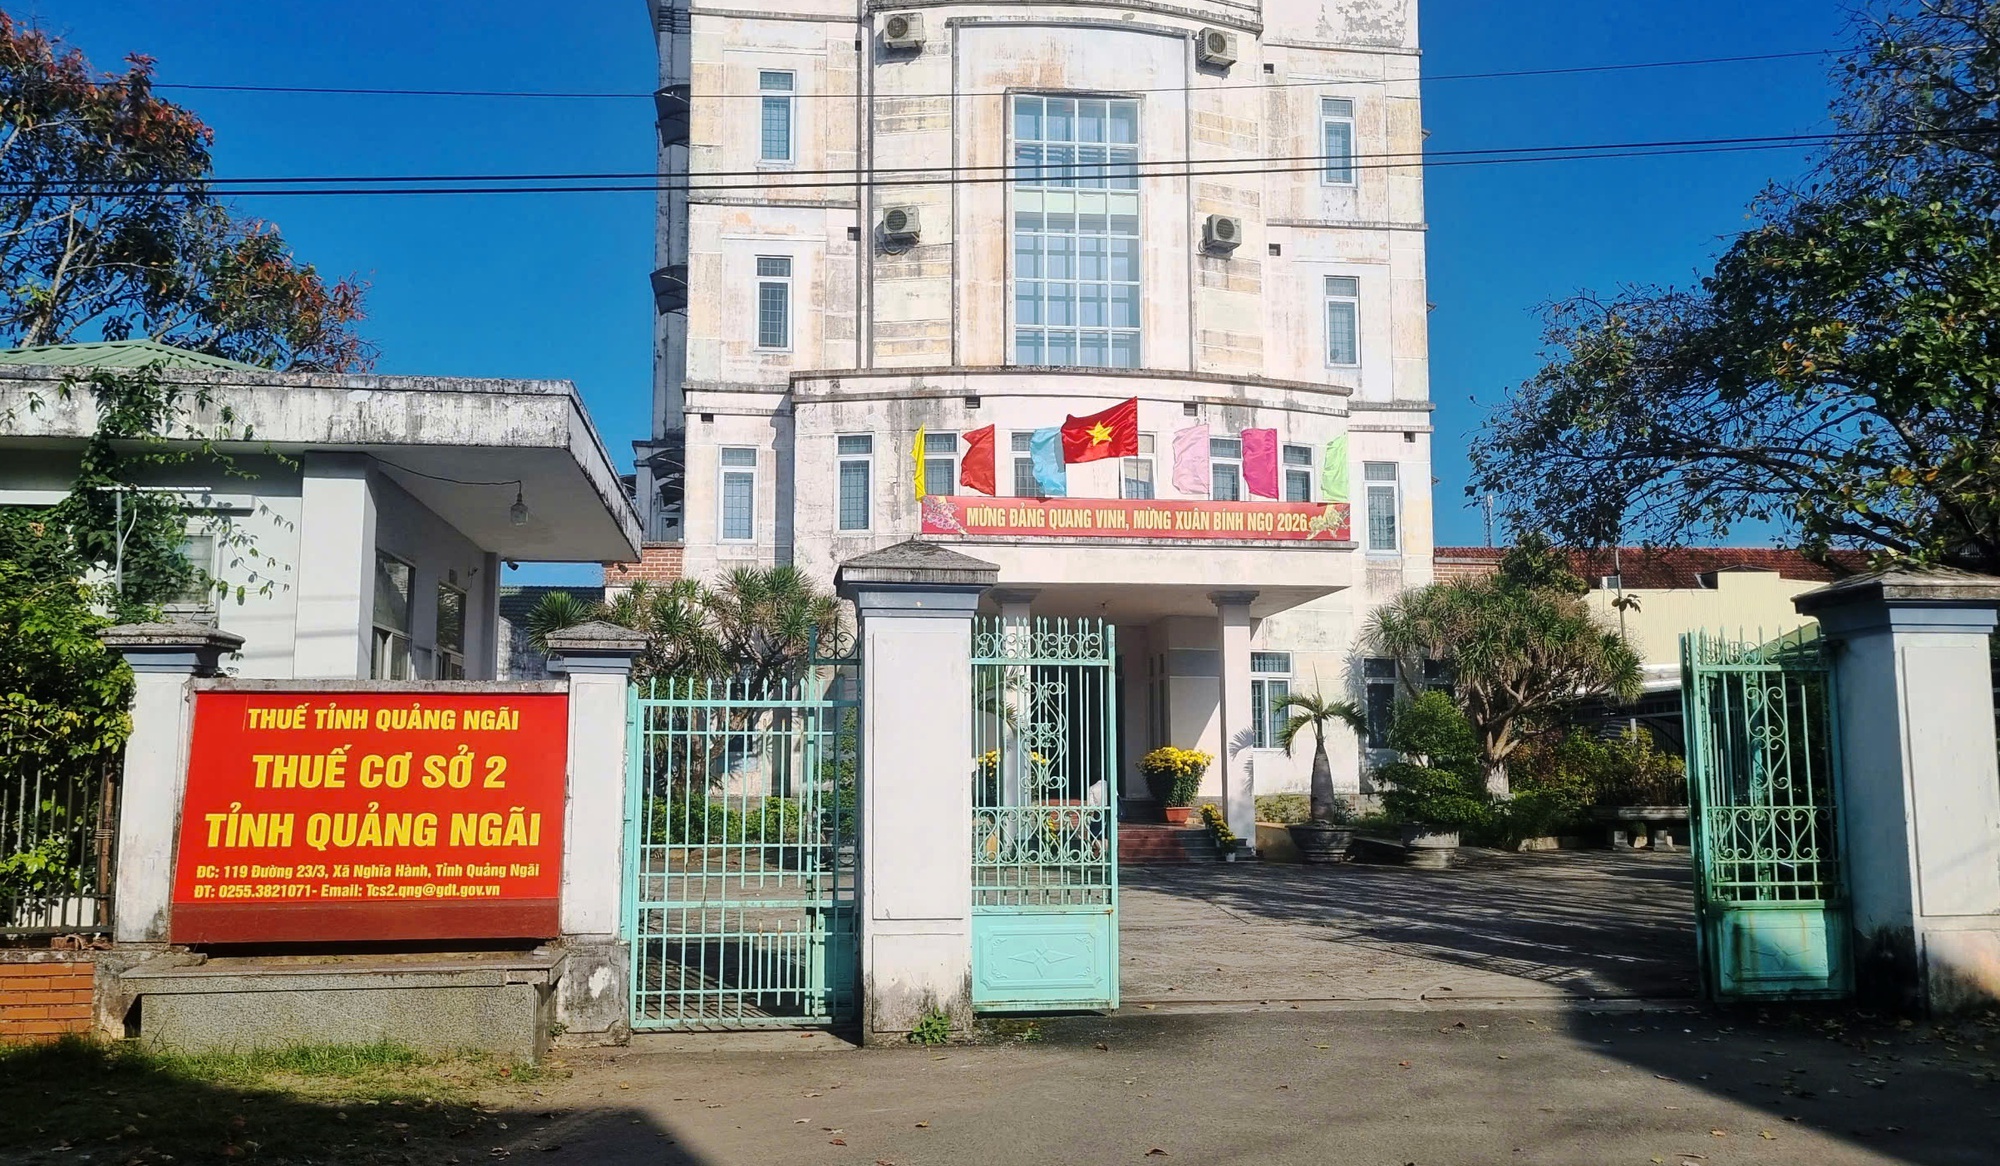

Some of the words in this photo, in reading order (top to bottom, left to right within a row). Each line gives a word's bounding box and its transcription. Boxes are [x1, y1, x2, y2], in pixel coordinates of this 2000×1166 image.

[967, 504, 1006, 527] MỪNG
[1009, 502, 1045, 528] ĐẢNG
[1049, 508, 1092, 530] QUANG
[1096, 509, 1129, 531] VINH,
[1134, 506, 1172, 529] MỪNG
[1175, 507, 1210, 530] XUÂN
[1247, 512, 1274, 536] NGỌ
[1277, 512, 1308, 532] 2026
[247, 703, 310, 730] THUẾ
[314, 703, 369, 730] TỈNH
[375, 704, 457, 732] QUẢNG
[462, 705, 519, 731] NGÃI
[252, 744, 352, 789] THUẾ
[359, 752, 413, 789] CƠ
[422, 744, 475, 789] SỞ
[483, 755, 508, 789] 2
[204, 802, 295, 848] TỈNH
[305, 801, 438, 852] QUẢNG
[449, 806, 541, 848] NGÃI
[196, 865, 220, 879] ĐC:
[223, 865, 248, 879] 119
[250, 864, 294, 880] Đường
[296, 864, 329, 880] 23/3,
[333, 864, 351, 879] Xã
[353, 863, 392, 880] Nghĩa
[395, 863, 432, 879] Hành,
[436, 861, 463, 877] Tỉnh
[466, 862, 507, 879] Quảng
[510, 863, 540, 879] Ngãi
[194, 885, 216, 899] ĐT:
[320, 884, 363, 898] Email:
[365, 882, 501, 899] Tcs2.qng@gdt.gov.vn
